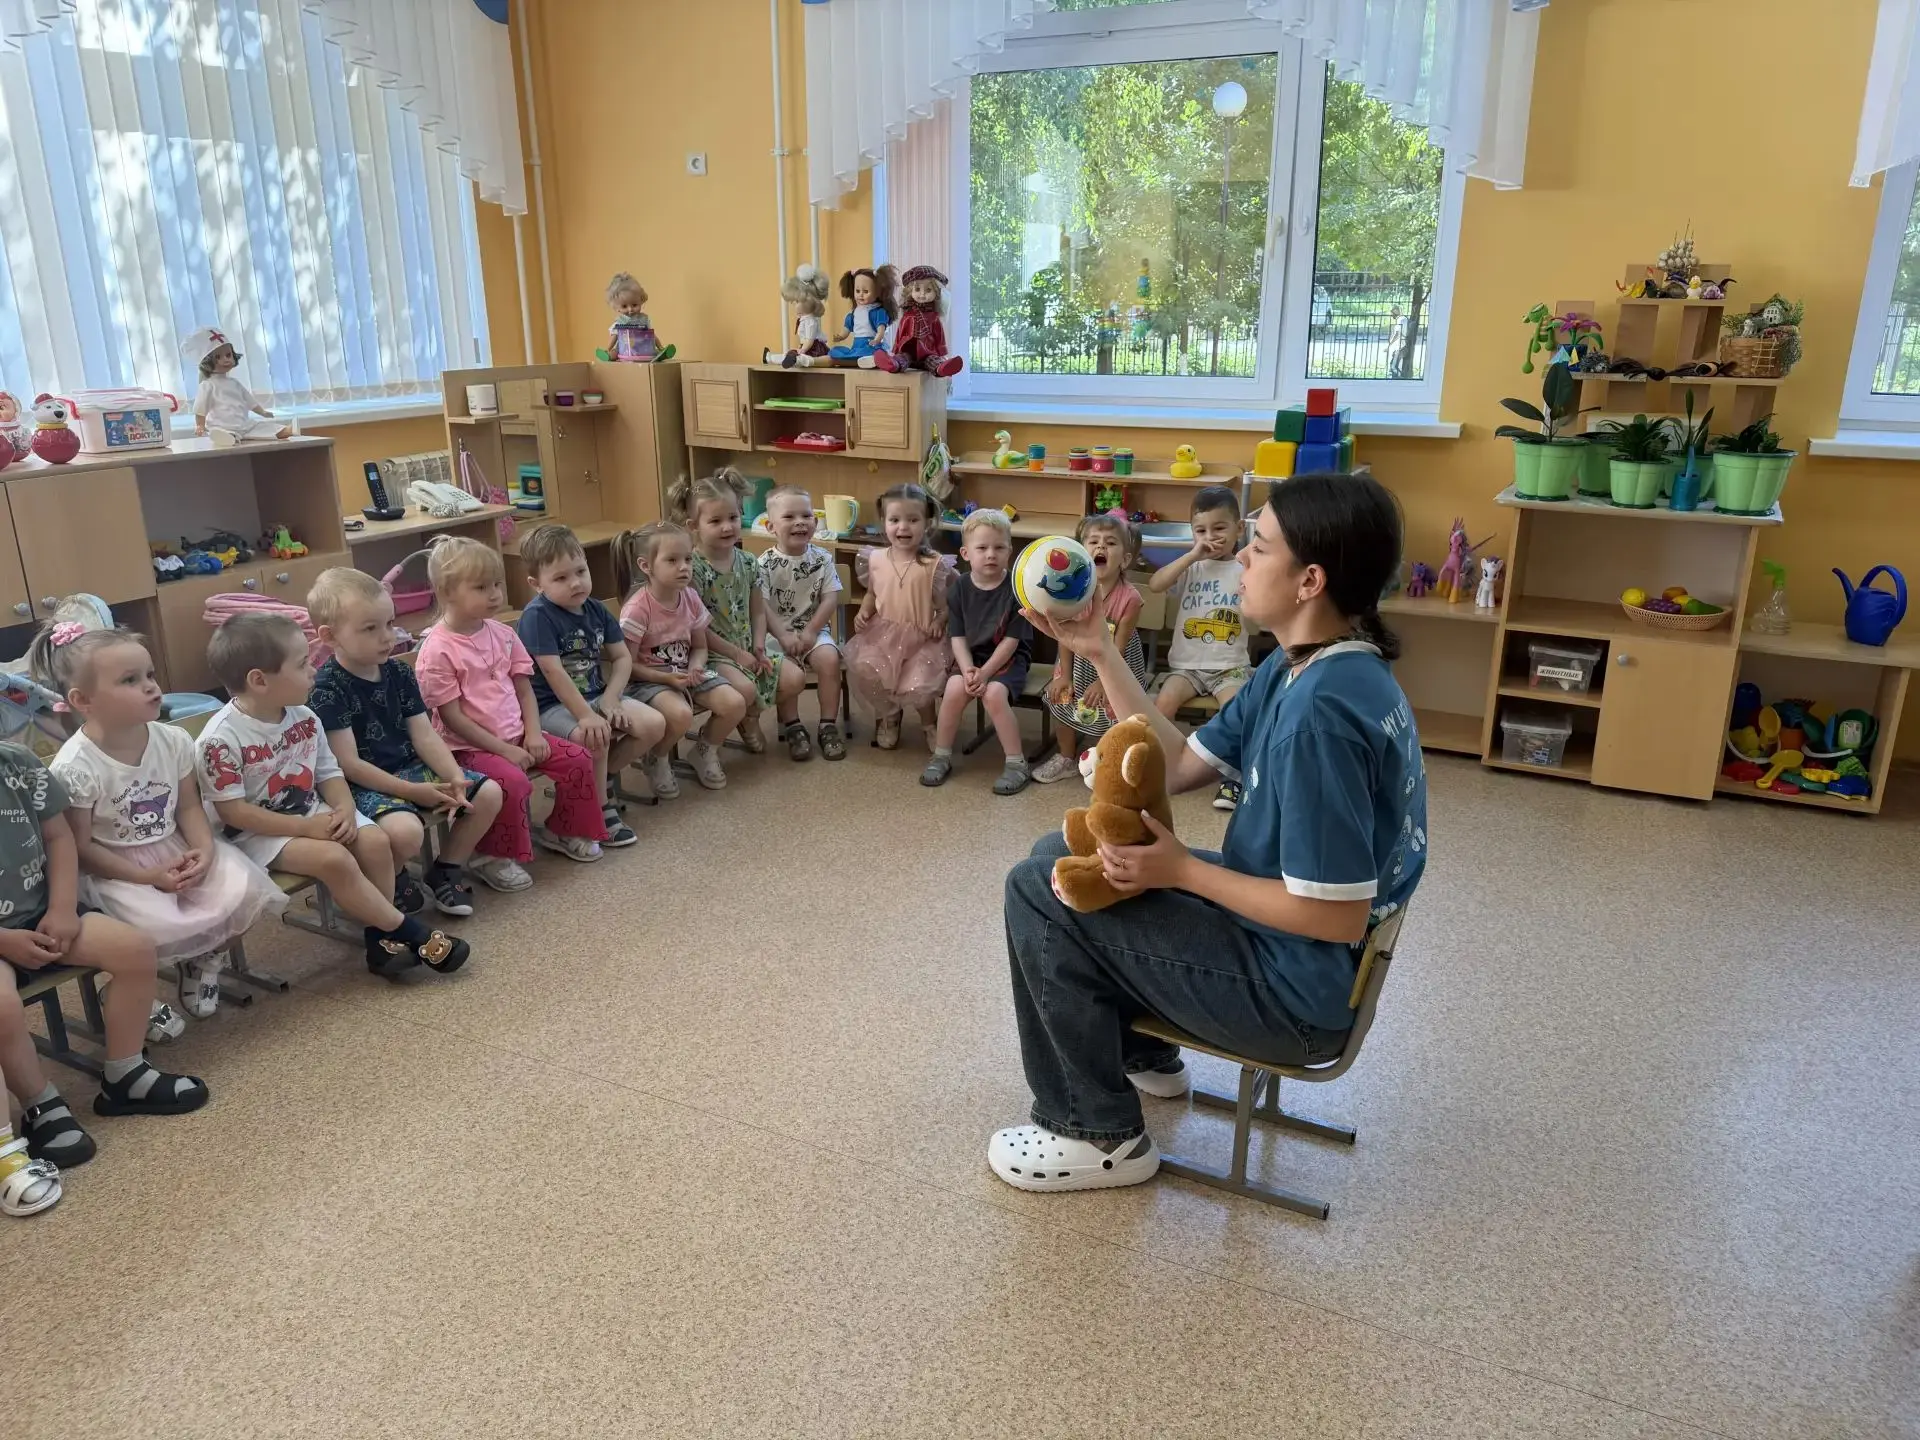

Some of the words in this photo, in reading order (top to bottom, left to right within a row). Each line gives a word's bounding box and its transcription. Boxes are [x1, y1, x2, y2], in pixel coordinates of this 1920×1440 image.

[129, 431, 162, 441] ДОКТОР
[1188, 580, 1220, 593] COME
[0, 808, 26, 816] HAPP
